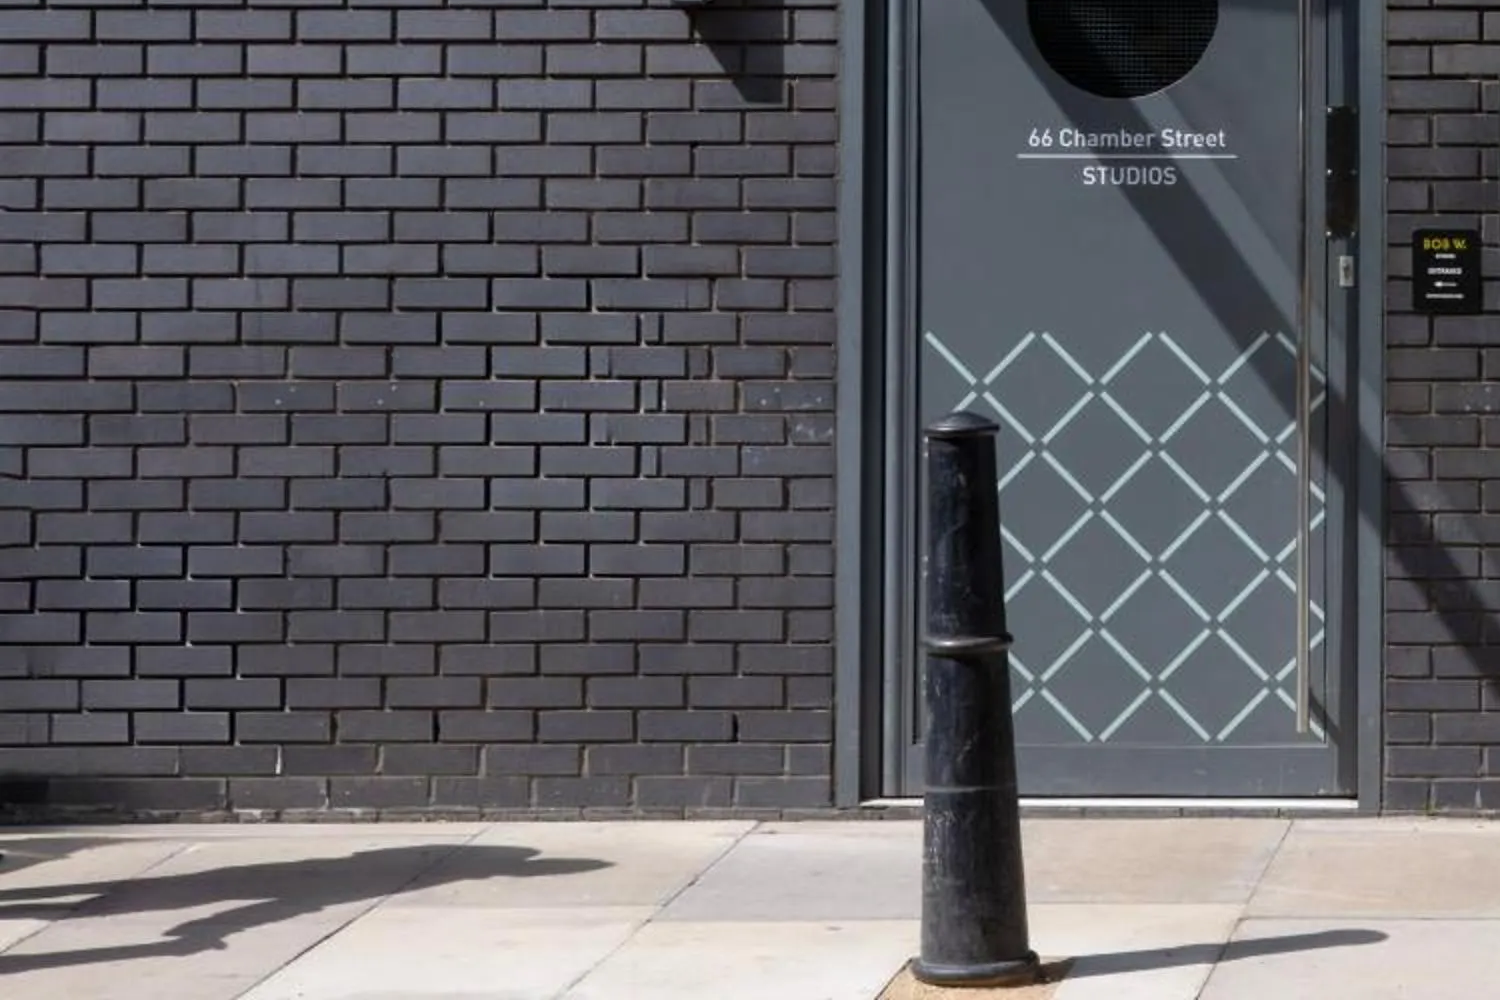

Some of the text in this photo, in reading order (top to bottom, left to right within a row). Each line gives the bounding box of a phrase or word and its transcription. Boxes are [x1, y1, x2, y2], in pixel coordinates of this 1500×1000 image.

[1028, 128, 1226, 148] 66 Chamber Street
[1083, 166, 1177, 185] STUDIOS
